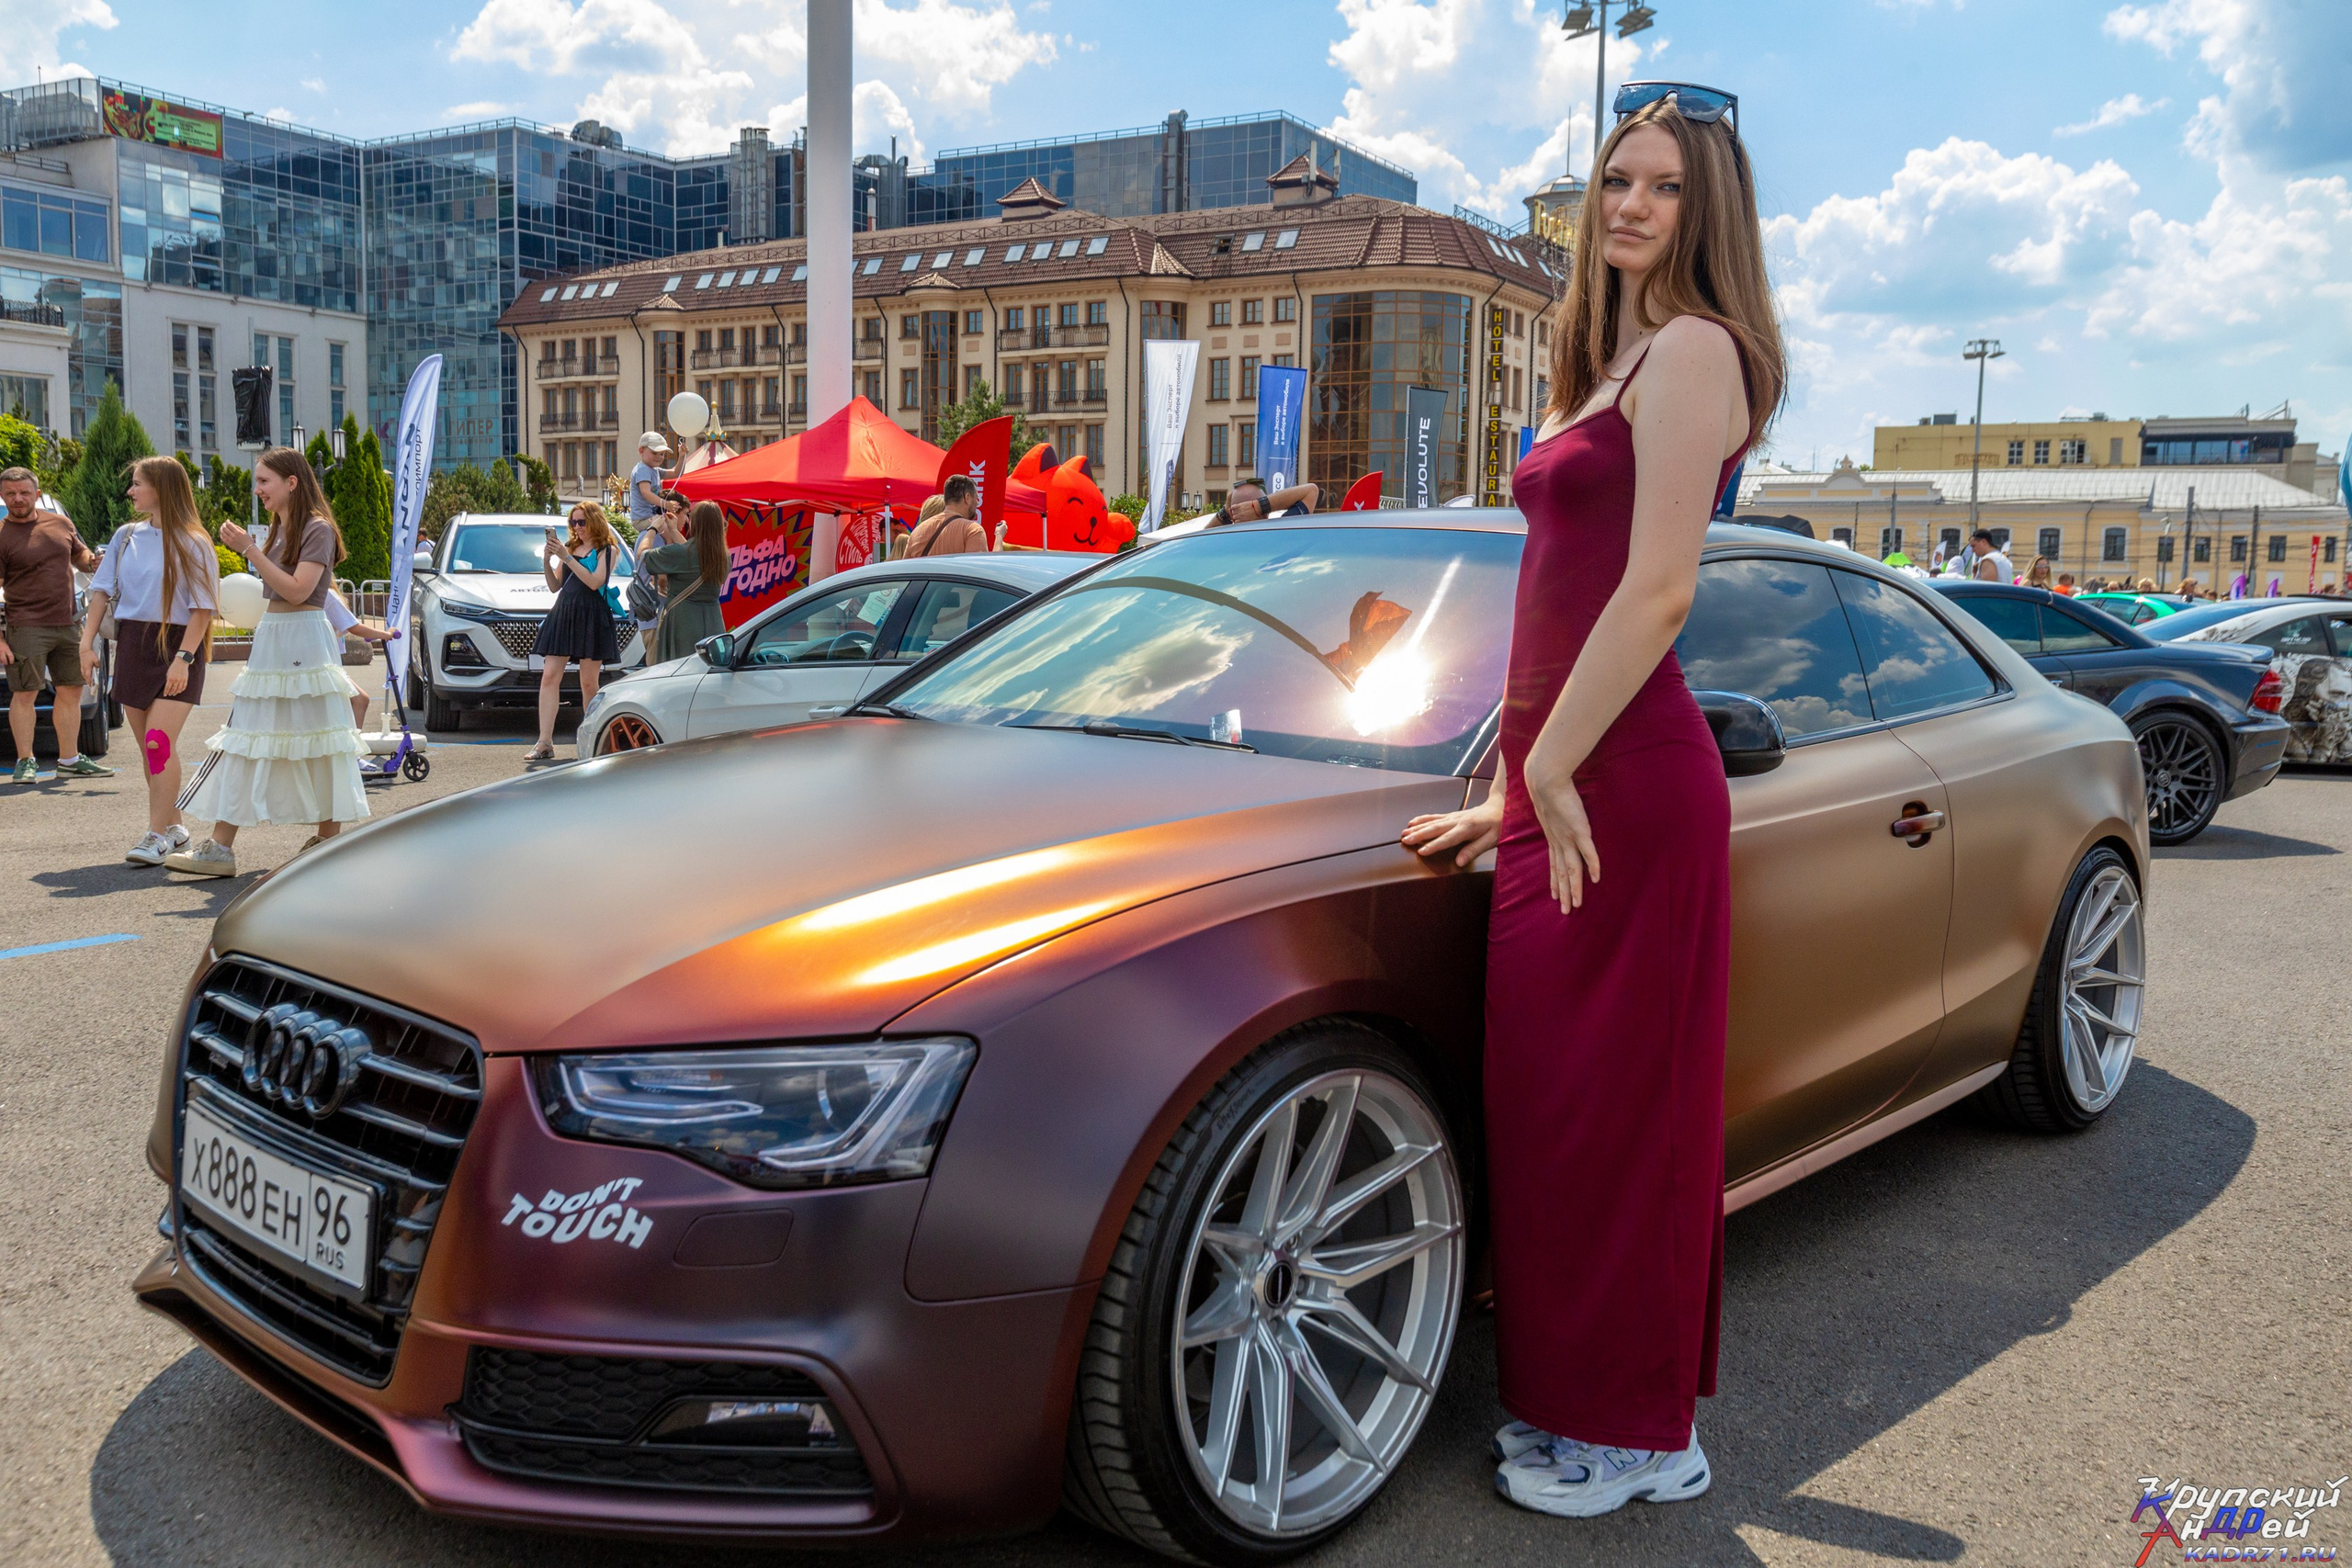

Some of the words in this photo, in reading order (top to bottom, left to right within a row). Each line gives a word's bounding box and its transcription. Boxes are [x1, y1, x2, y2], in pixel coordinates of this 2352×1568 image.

[1492, 310, 1502, 381] HOTEL
[1282, 378, 1291, 416] автомобиля
[1418, 417, 1430, 508] EVOLUTE
[719, 554, 796, 596] ГОДНО
[315, 1186, 351, 1246] 96
[538, 1177, 643, 1214] DON'T
[501, 1192, 654, 1249] TOUCH
[316, 1243, 345, 1269] RUS
